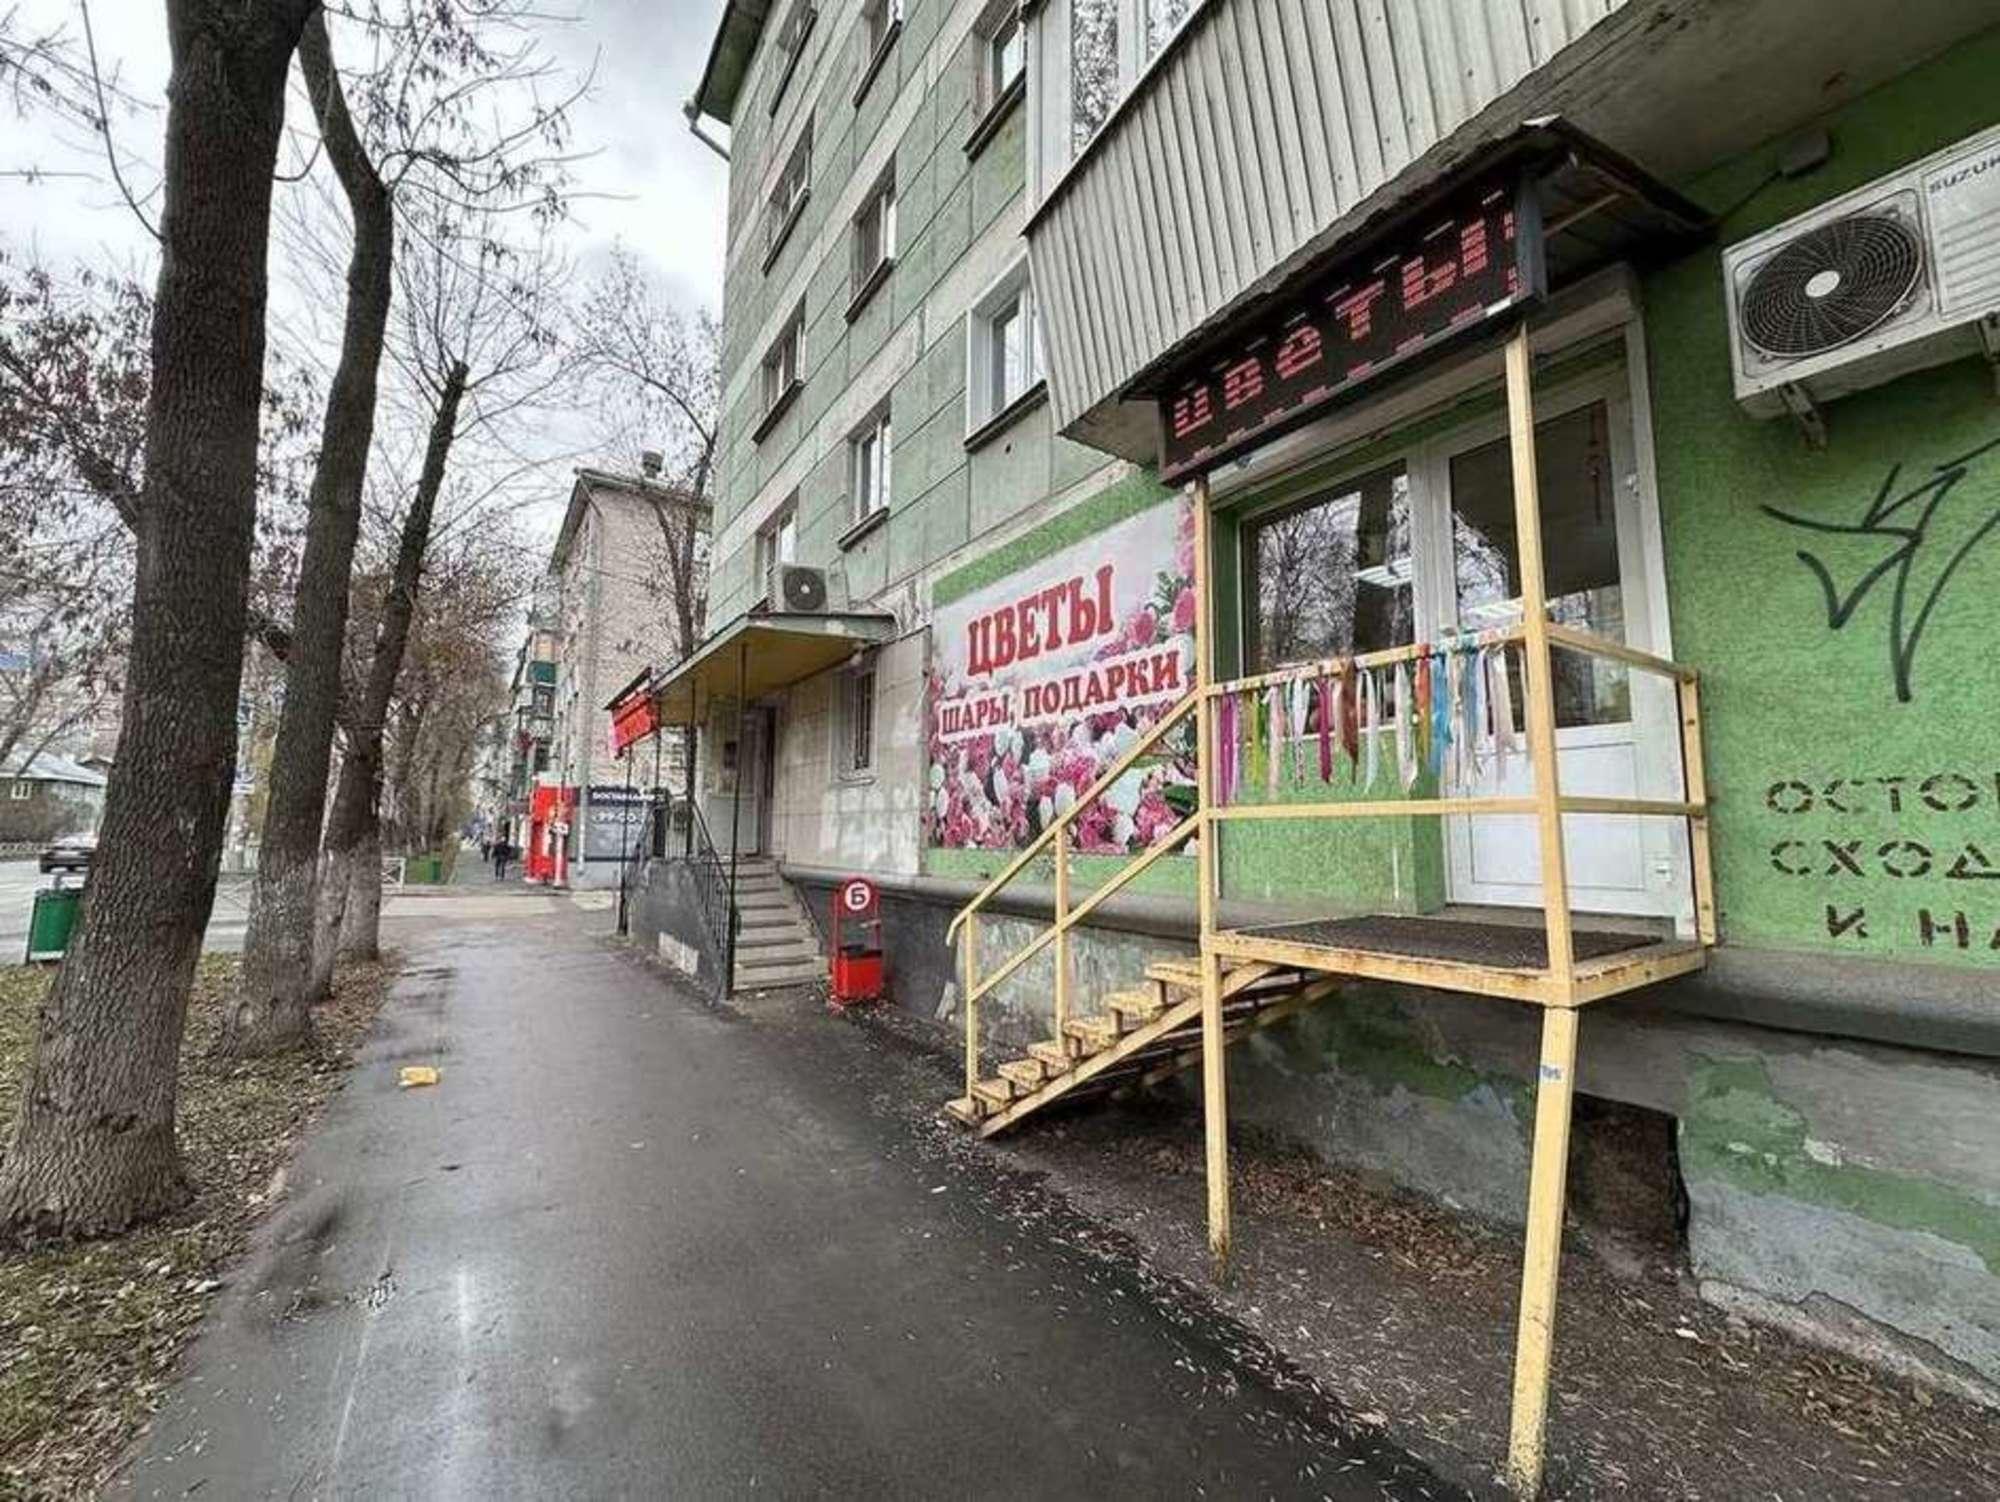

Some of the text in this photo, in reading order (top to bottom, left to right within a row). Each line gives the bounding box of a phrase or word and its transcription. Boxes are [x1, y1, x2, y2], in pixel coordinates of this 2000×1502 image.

[967, 564, 1114, 677] ЦВЕТЫ
[942, 650, 1180, 736] ШАРЫ, ПОДАРКИ
